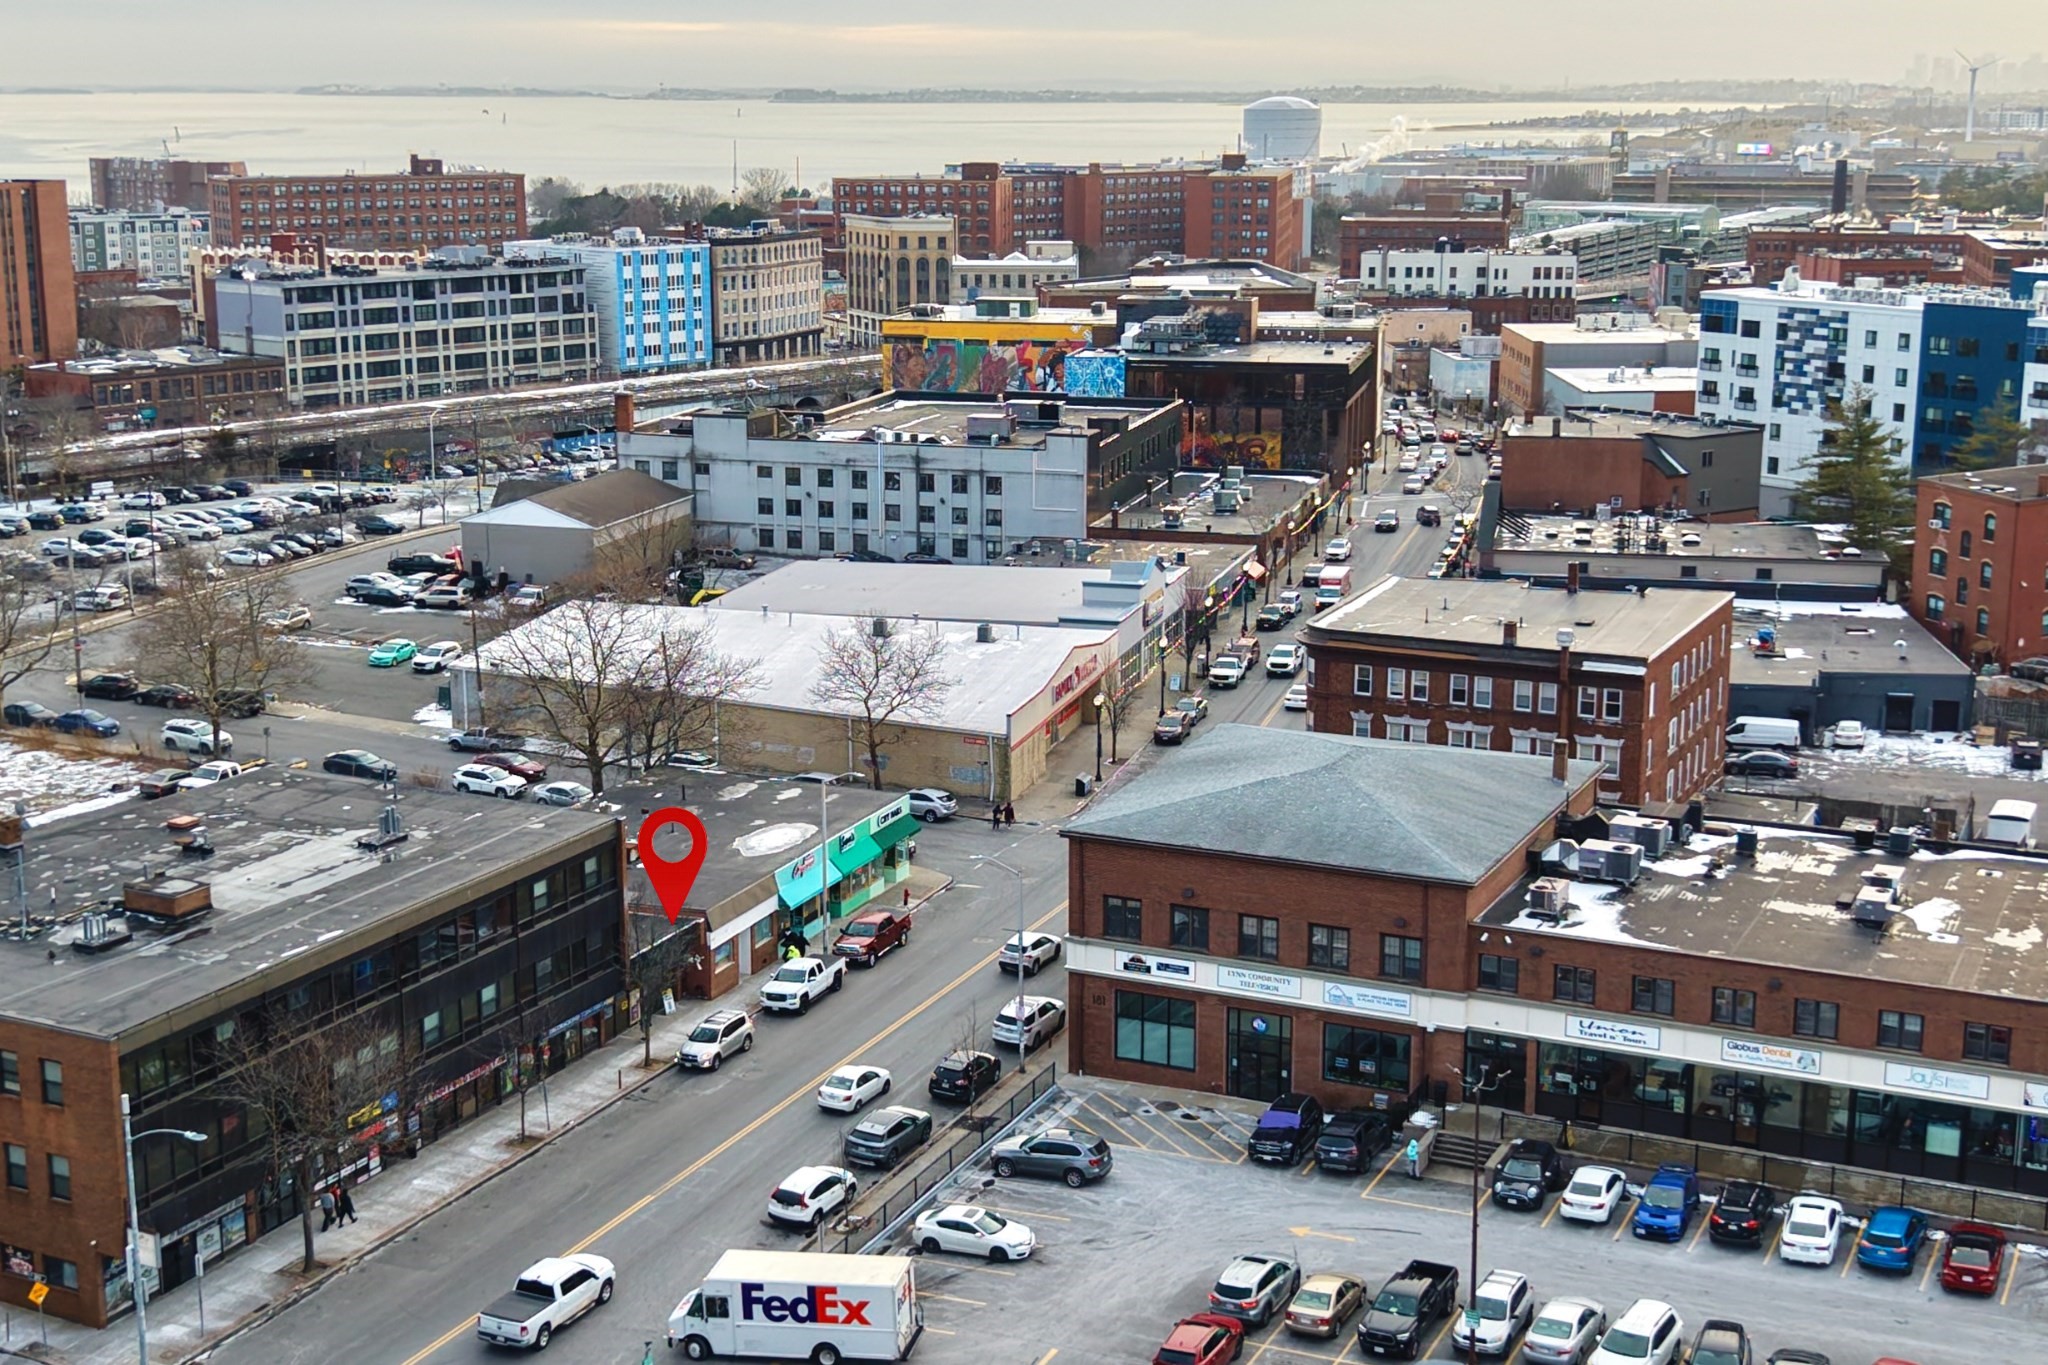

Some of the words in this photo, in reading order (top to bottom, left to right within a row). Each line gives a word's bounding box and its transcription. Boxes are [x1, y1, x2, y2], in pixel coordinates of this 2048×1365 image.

[1227, 970, 1246, 979] LYNN
[1248, 973, 1292, 986] COMMUNITY
[1240, 981, 1280, 992] TELEVISION
[1578, 1019, 1647, 1037] Union
[1578, 1029, 1607, 1039] Travel
[1622, 1035, 1647, 1045] Tours
[1727, 1040, 1760, 1054] Globus
[1762, 1045, 1792, 1058] Dental
[740, 1282, 872, 1326] FedEx
